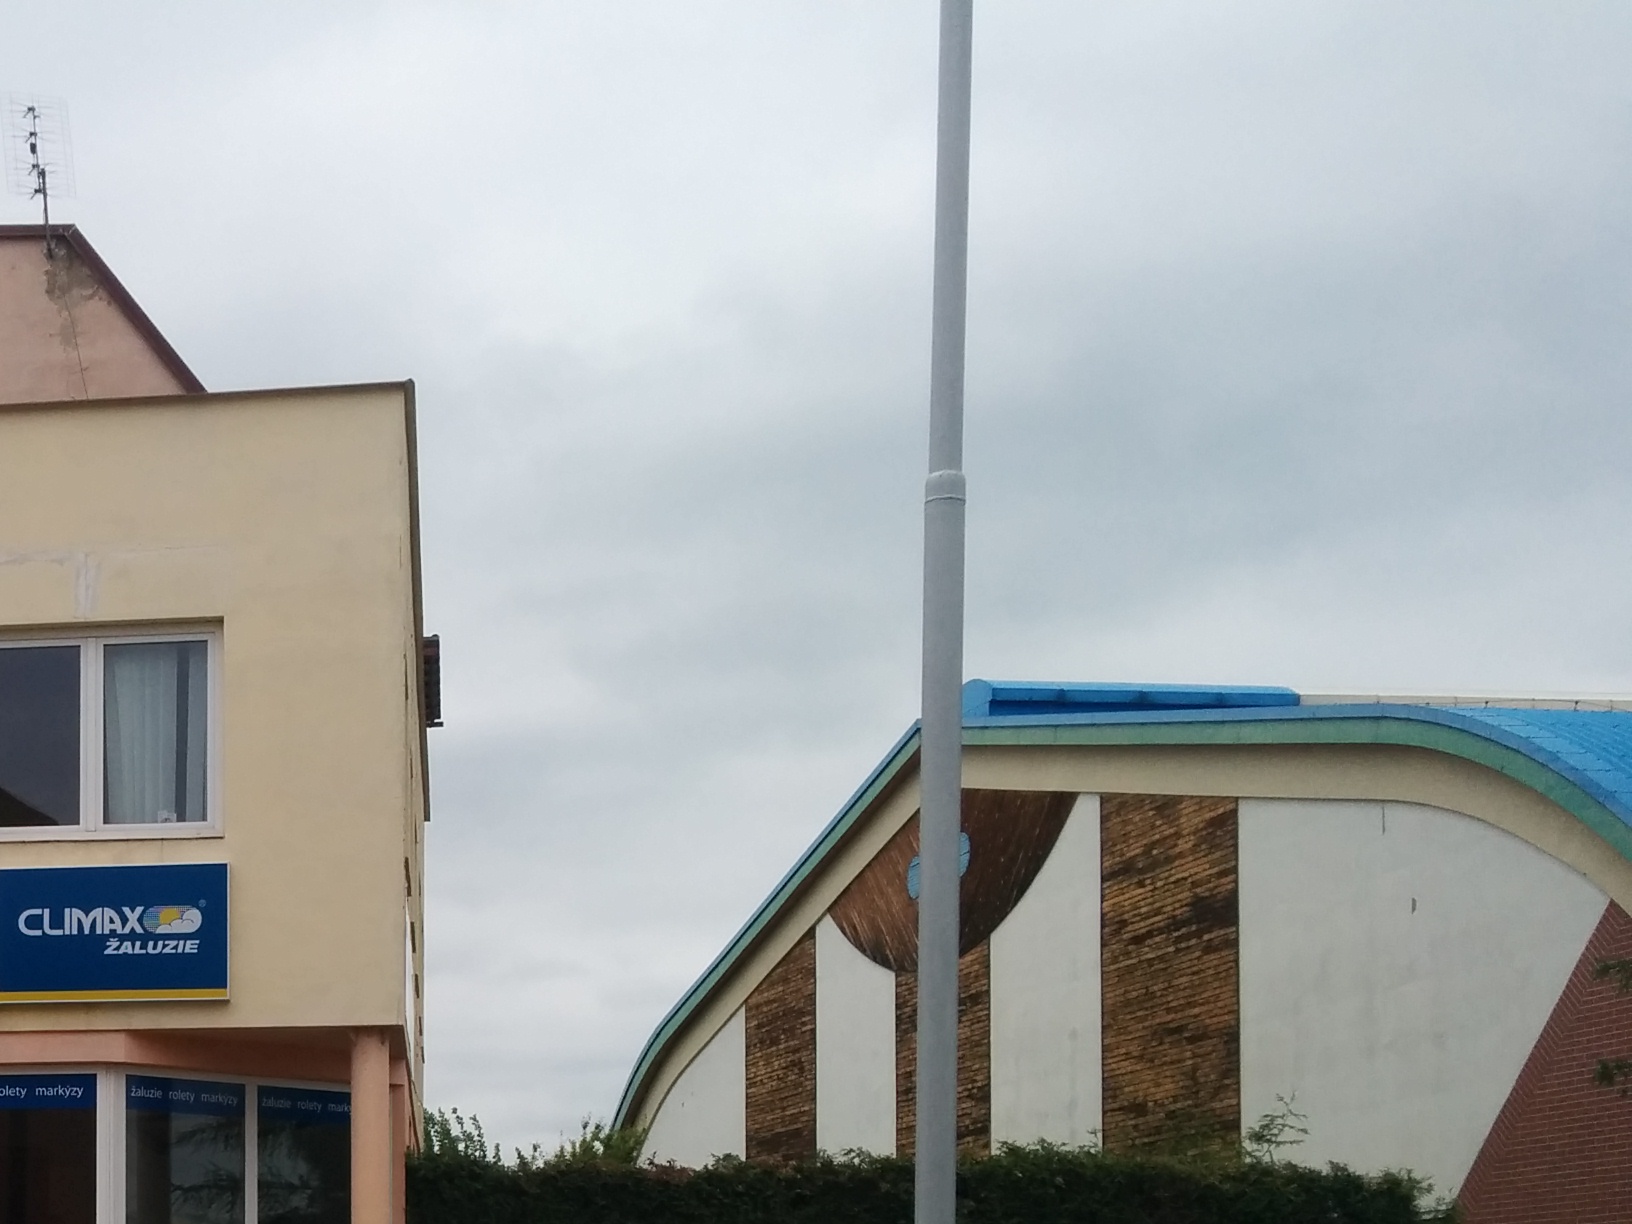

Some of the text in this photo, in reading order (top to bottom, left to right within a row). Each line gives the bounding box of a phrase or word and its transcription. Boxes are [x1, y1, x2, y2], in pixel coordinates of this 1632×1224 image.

[18, 906, 145, 936] CLIMAX
[103, 938, 200, 955] ŽALUZIE
[35, 1084, 84, 1098] markýzy
[130, 1085, 163, 1099] žaluzie
[168, 1089, 196, 1103] rolety
[297, 1100, 322, 1113] rolety
